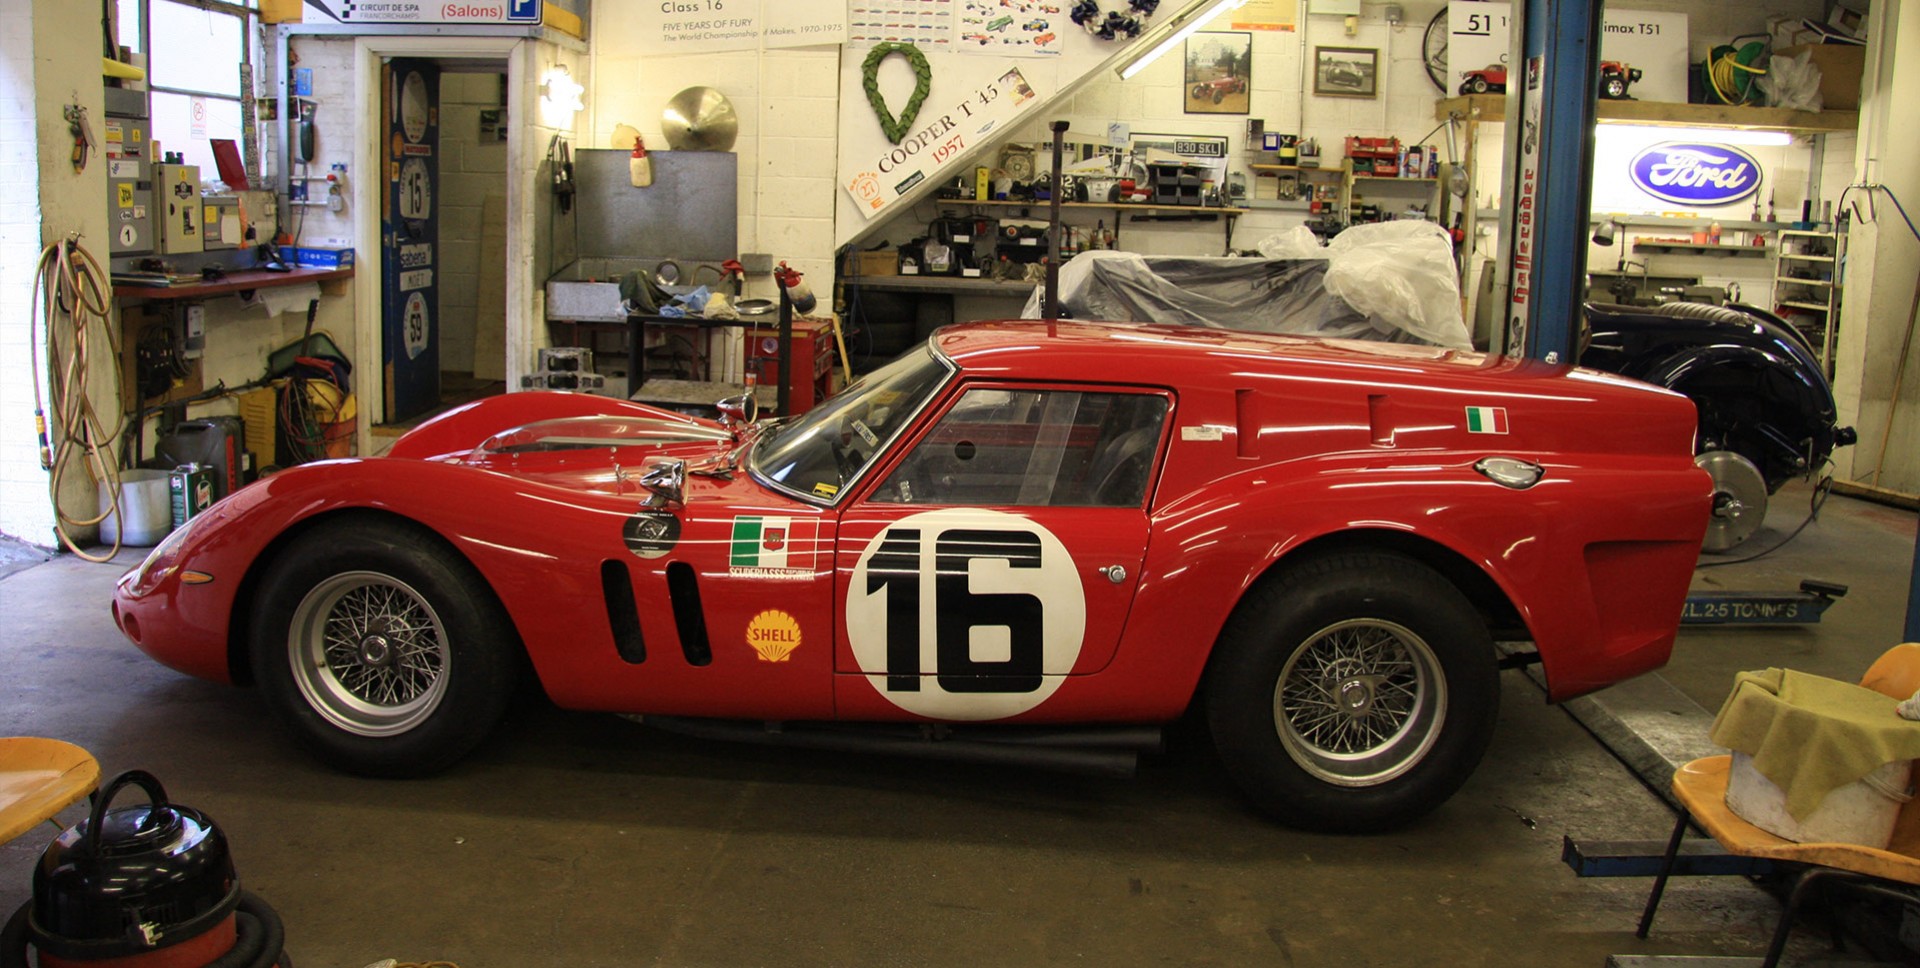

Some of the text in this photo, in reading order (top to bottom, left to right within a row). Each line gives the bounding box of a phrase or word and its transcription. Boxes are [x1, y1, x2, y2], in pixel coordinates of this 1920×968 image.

[441, 4, 504, 20] (Salons)
[661, 0, 723, 13] Class 16
[663, 19, 752, 31] FIVE YEARS OF FURY
[1468, 14, 1491, 32] 51
[1638, 23, 1660, 35] T51
[663, 34, 677, 42] The
[679, 32, 701, 41] World
[703, 31, 758, 41] Championship
[800, 24, 842, 33] 1970-1975
[878, 115, 957, 174] COOPER
[957, 100, 973, 118] T
[931, 134, 966, 164] 1957
[1177, 143, 1217, 154] 830 SKL
[1649, 149, 1748, 189] Ford
[408, 172, 421, 214] 15
[861, 181, 876, 197] 27
[125, 229, 131, 242] 1
[410, 313, 422, 343] 59
[866, 528, 1044, 693] 16
[753, 628, 795, 642] SHELL
